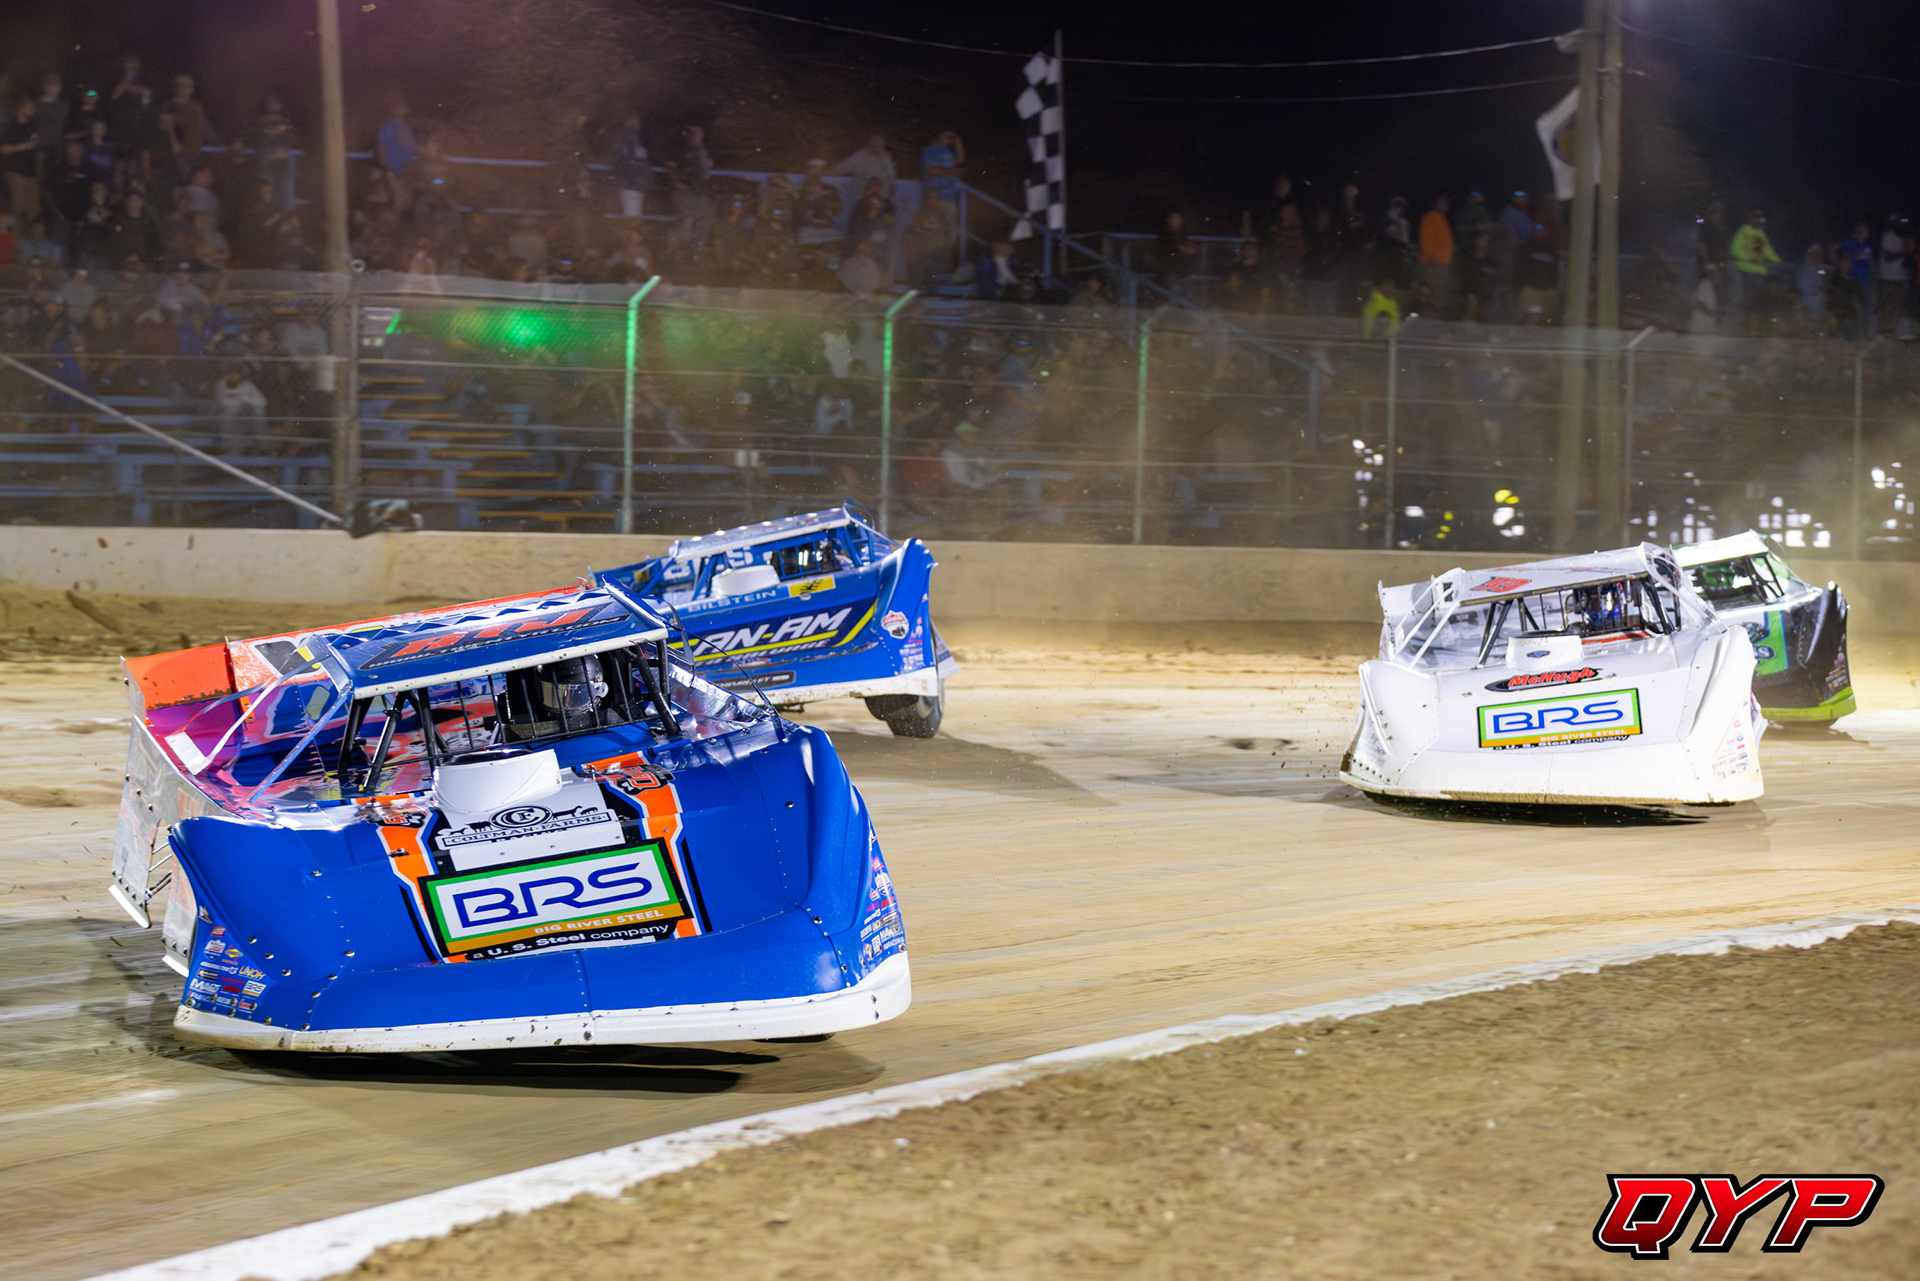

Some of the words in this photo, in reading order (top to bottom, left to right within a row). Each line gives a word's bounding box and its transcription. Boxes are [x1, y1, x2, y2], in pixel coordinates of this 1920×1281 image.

[1508, 667, 1595, 687] McHugh
[1493, 700, 1624, 733] BRS
[1574, 735, 1629, 745] company
[452, 862, 653, 929] BRS
[534, 923, 562, 935] BIG
[566, 916, 613, 930] RIVER
[617, 909, 665, 923] STEEL
[472, 952, 485, 960] a
[487, 942, 509, 955] U.
[511, 937, 532, 951] S.
[536, 931, 586, 947] Steel
[590, 924, 669, 941] company
